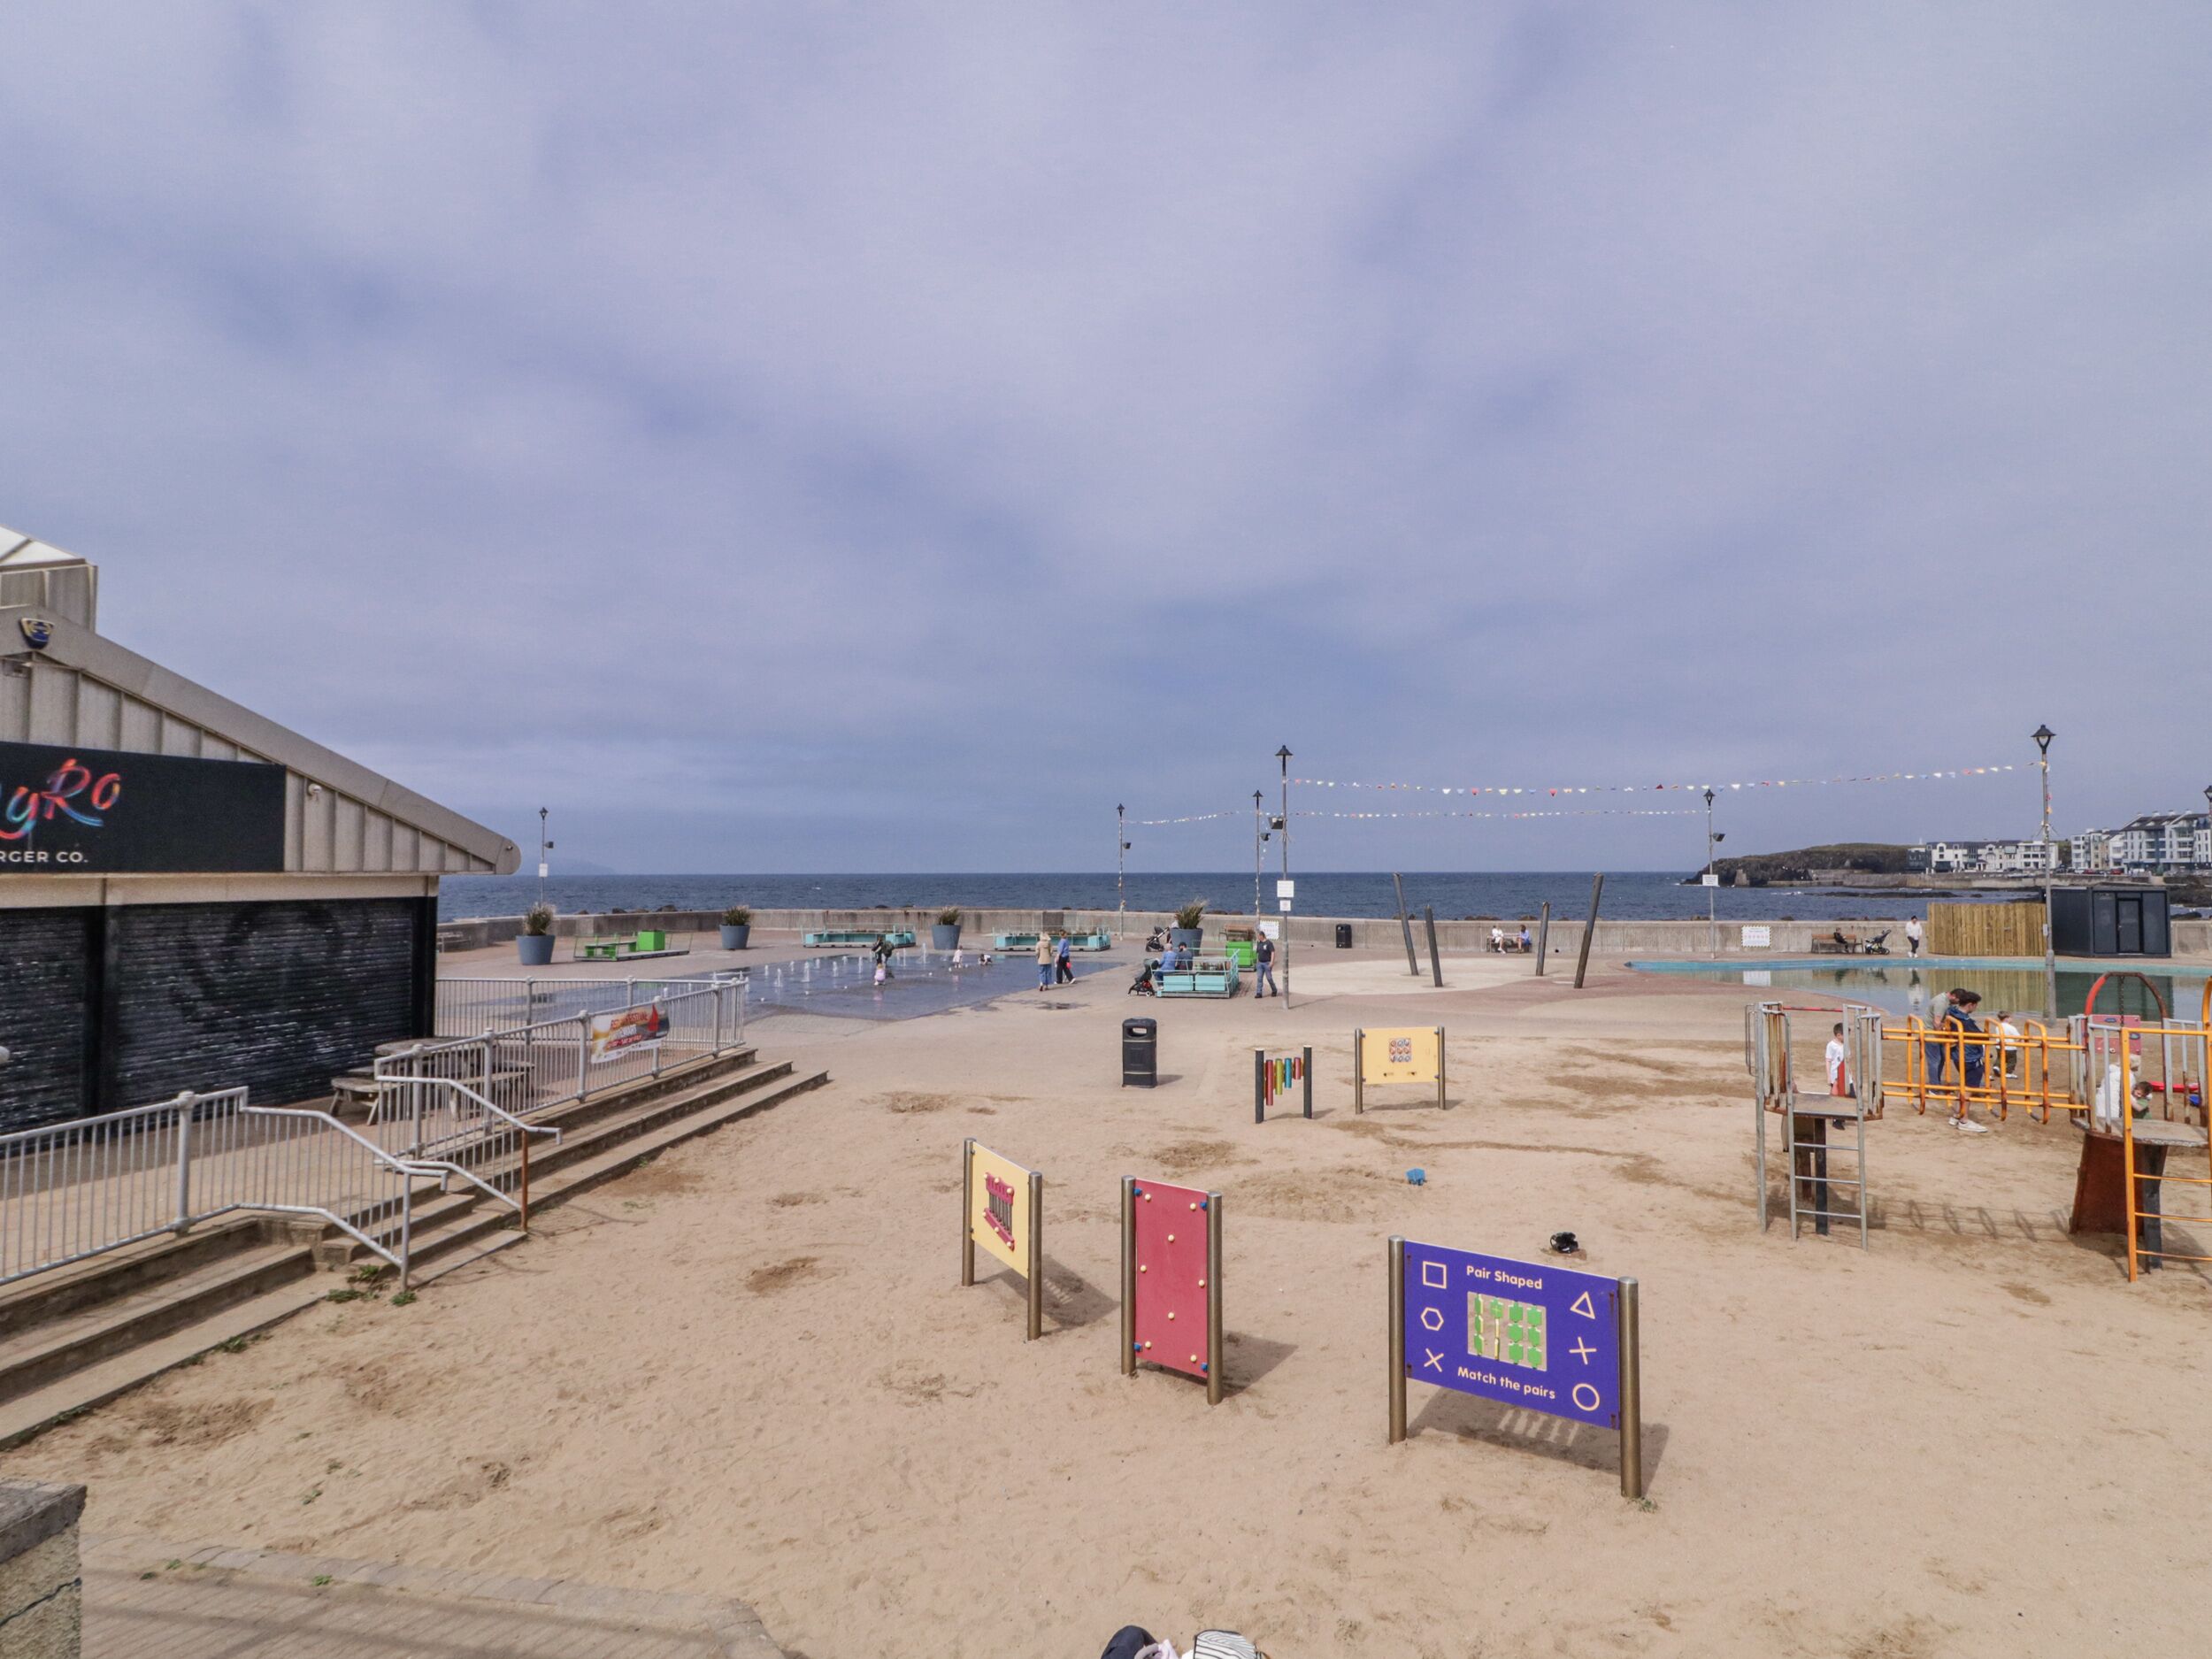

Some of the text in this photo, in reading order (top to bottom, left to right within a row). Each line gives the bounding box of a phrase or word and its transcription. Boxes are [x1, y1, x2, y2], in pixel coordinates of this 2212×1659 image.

[56, 851, 88, 863] CO.
[1466, 1265, 1542, 1289] Pair Shaped
[1457, 1366, 1555, 1400] Match the pairs
